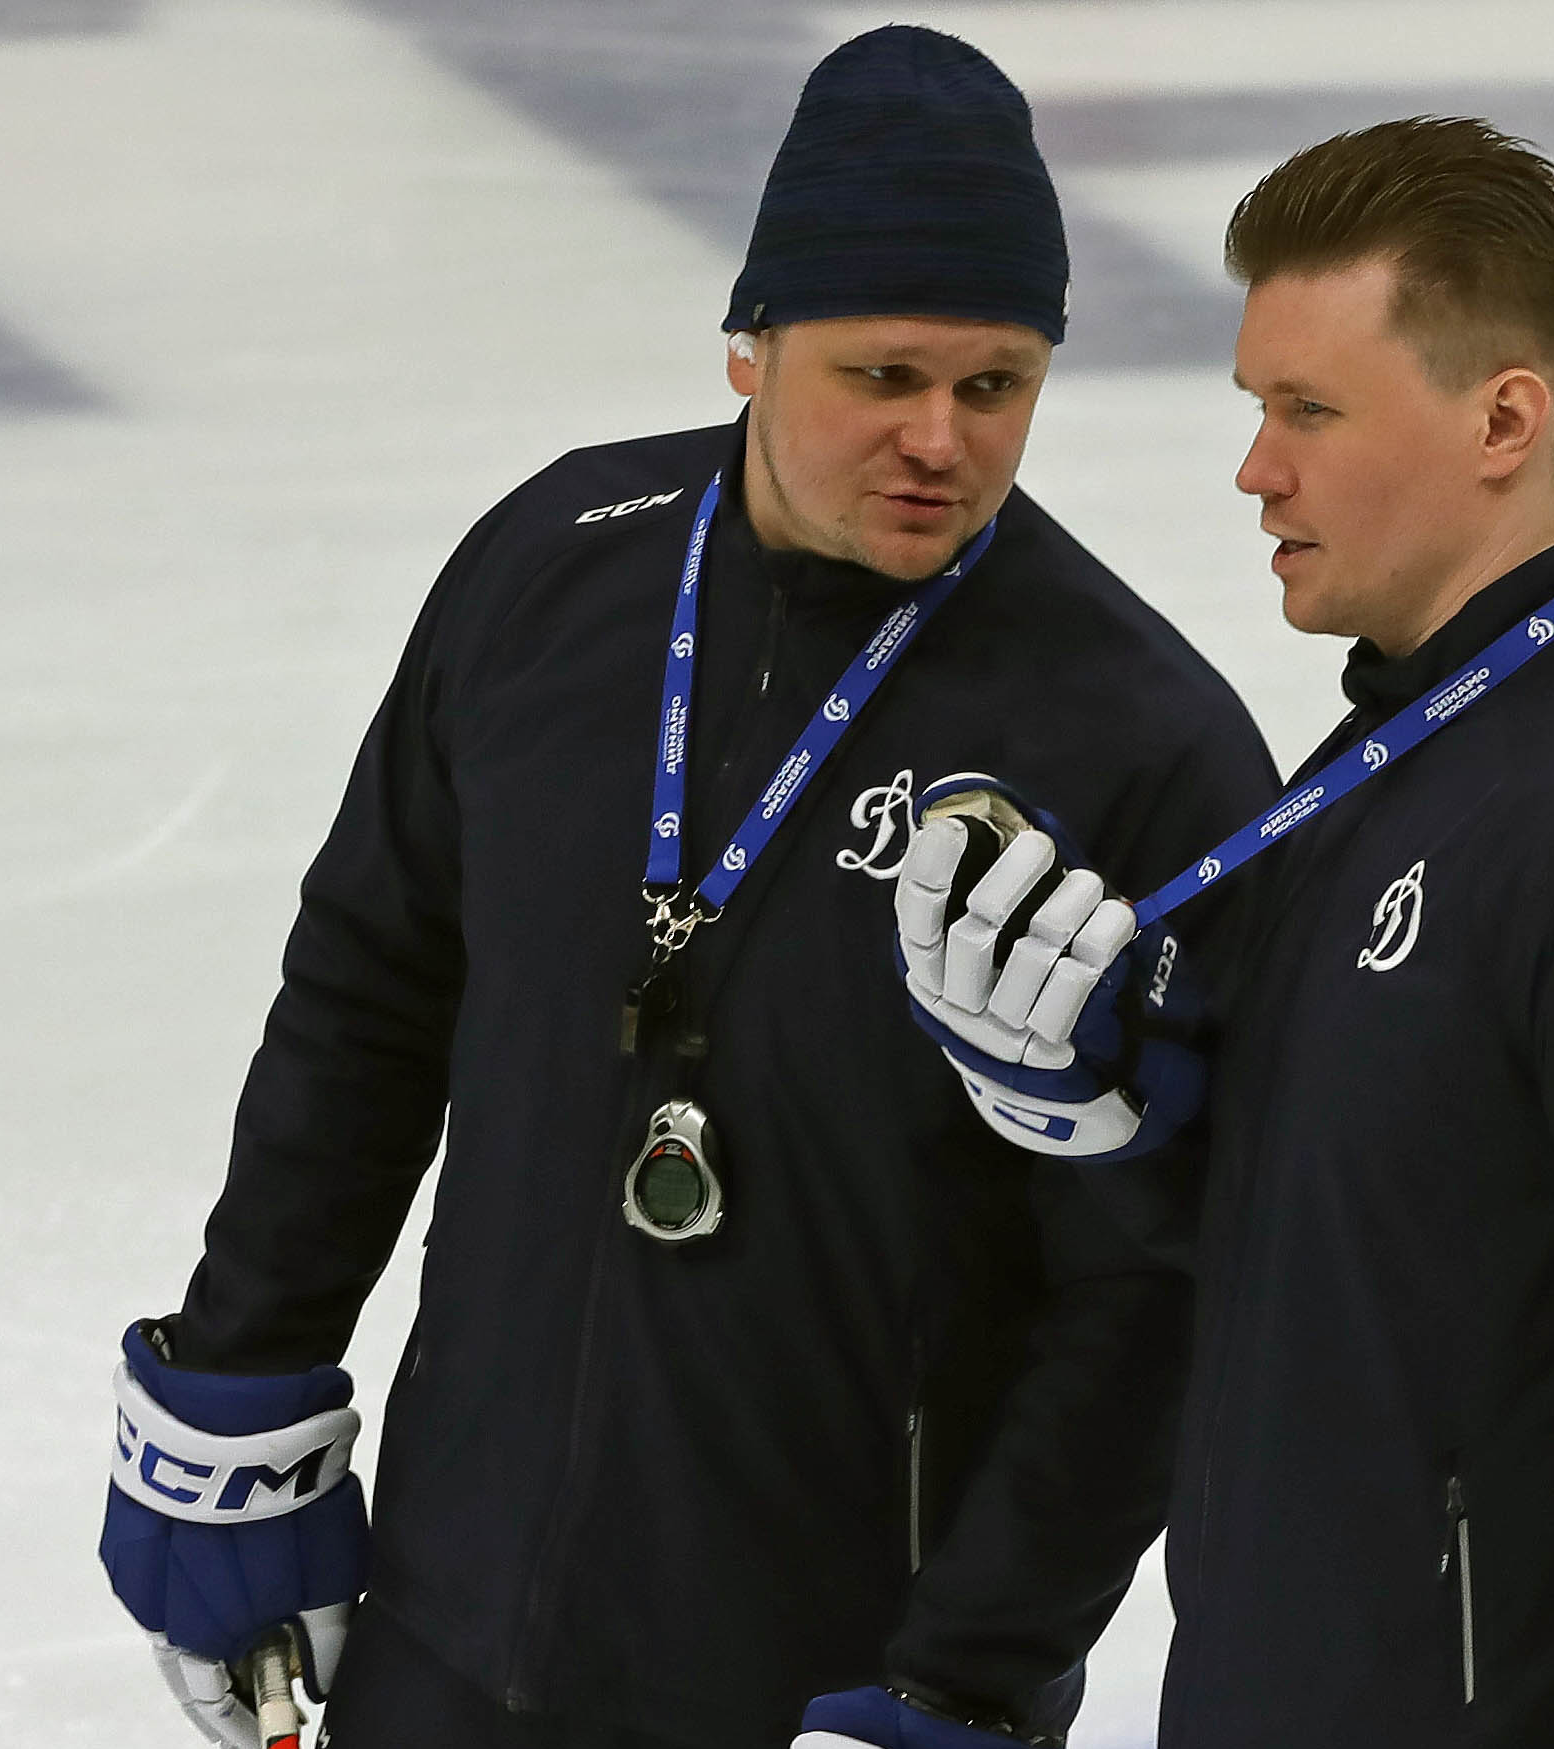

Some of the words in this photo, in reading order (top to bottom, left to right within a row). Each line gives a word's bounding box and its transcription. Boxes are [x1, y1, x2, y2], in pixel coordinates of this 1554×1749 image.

[574, 487, 684, 525] CCM
[866, 601, 919, 671] ДИНАМО
[1424, 667, 1490, 722] ДИНАМО
[1439, 683, 1488, 721] МОСКВА
[666, 695, 682, 775] ДИНАМО
[761, 749, 812, 819] ДИНАМО
[1260, 786, 1325, 839] ДИНАМО
[1271, 802, 1320, 838] МОСКВА
[1148, 935, 1179, 1008] CCM
[117, 1404, 338, 1511] CCM
